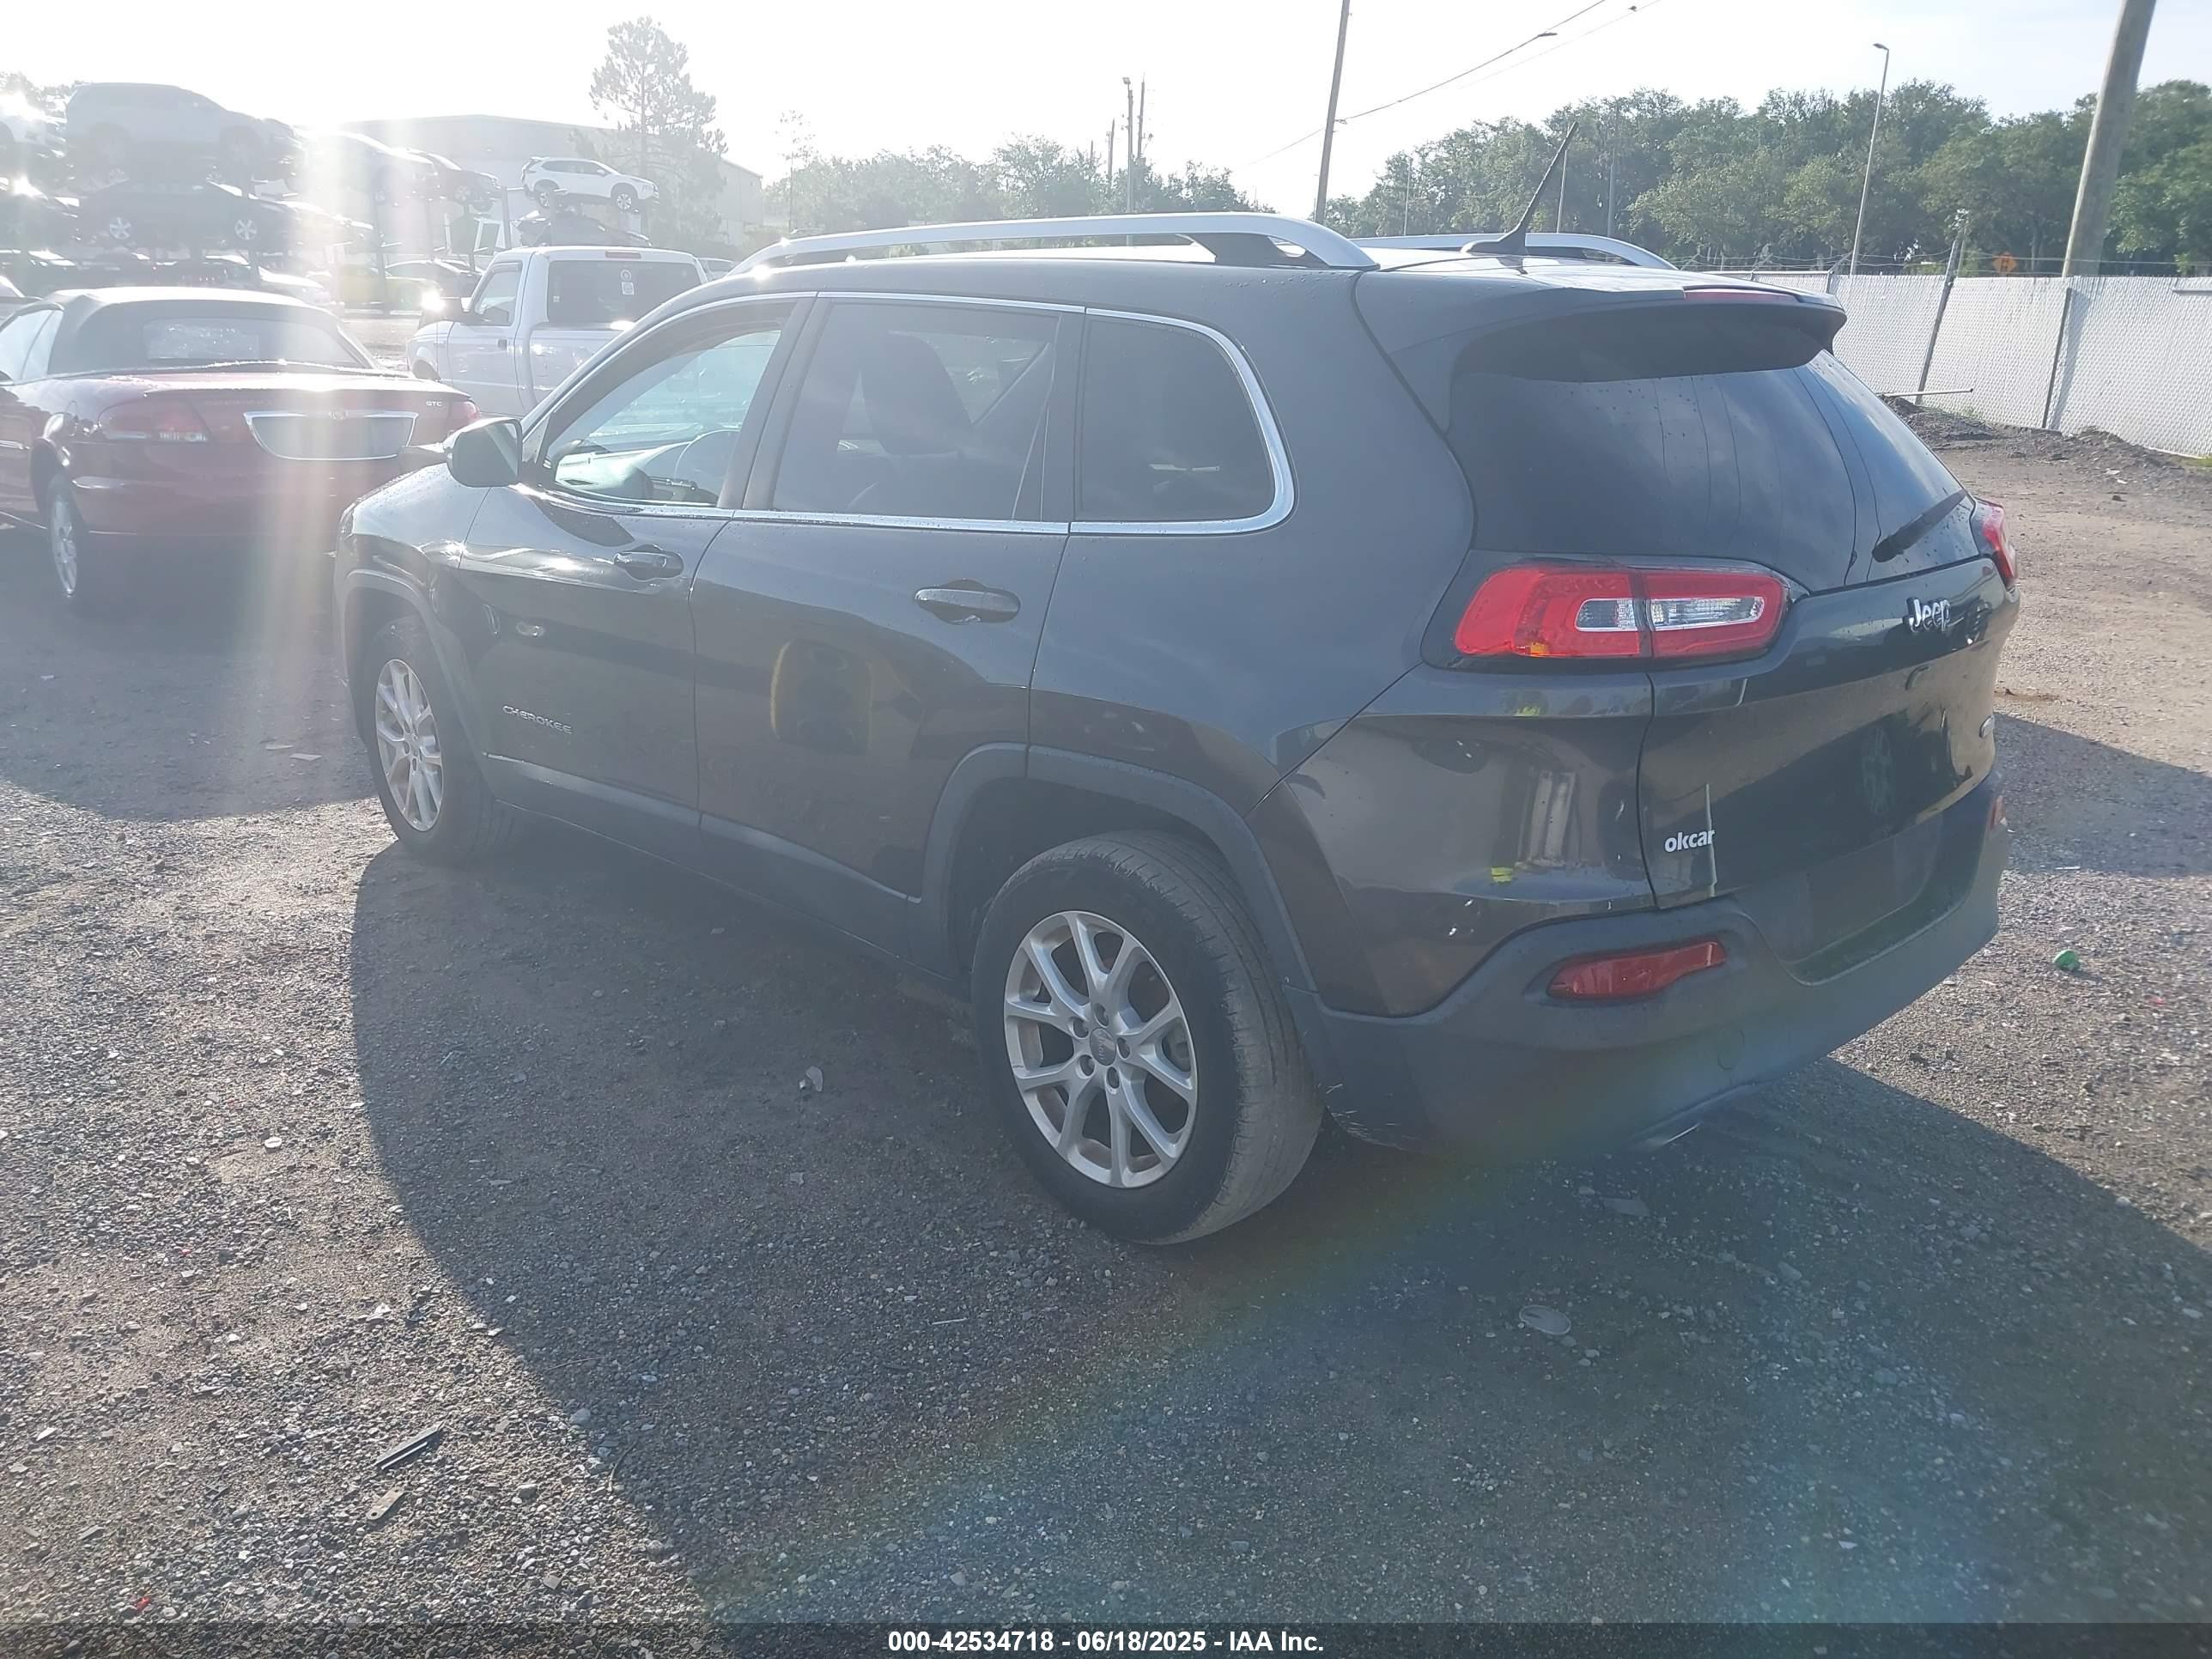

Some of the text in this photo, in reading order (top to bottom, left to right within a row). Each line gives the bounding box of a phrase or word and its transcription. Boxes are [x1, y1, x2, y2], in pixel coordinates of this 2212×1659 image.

[1908, 598, 1952, 633] Jeep
[501, 705, 573, 735] CHEROKEE
[1664, 829, 1716, 853] okcar
